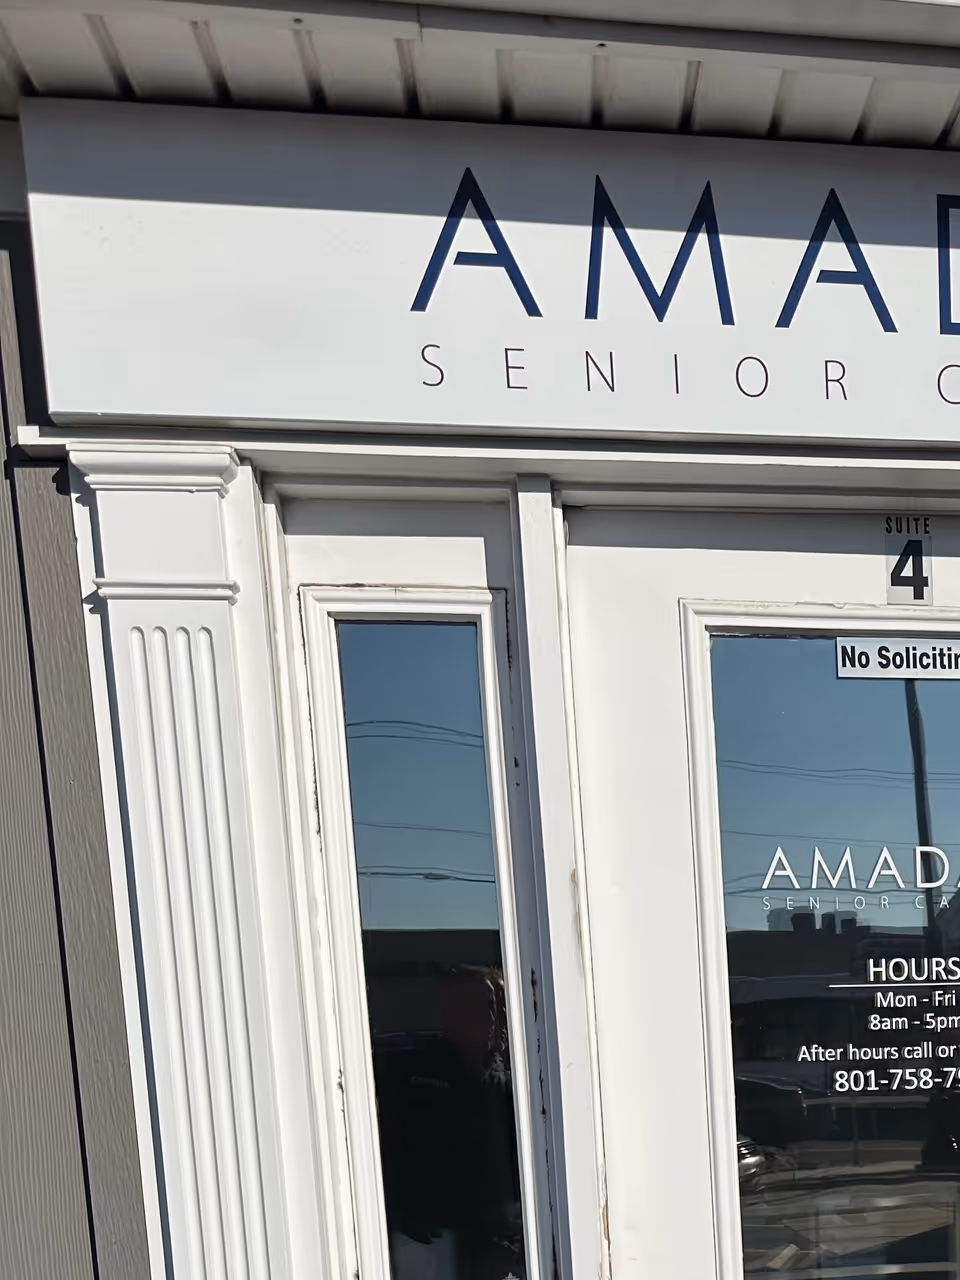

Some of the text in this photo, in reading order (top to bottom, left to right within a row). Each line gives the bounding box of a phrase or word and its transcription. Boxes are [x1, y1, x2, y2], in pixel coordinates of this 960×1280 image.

[420, 343, 849, 401] SENIOR
[885, 516, 931, 535] SUITE
[890, 539, 929, 601] 4
[840, 645, 870, 669] No
[762, 895, 890, 910] SENIOR
[876, 991, 918, 1008] Mon
[934, 990, 956, 1007] Fri
[869, 1013, 909, 1031] 8am
[797, 1045, 844, 1062] After
[848, 1043, 900, 1061] hours
[903, 1041, 933, 1059] call
[937, 1045, 957, 1059] or
